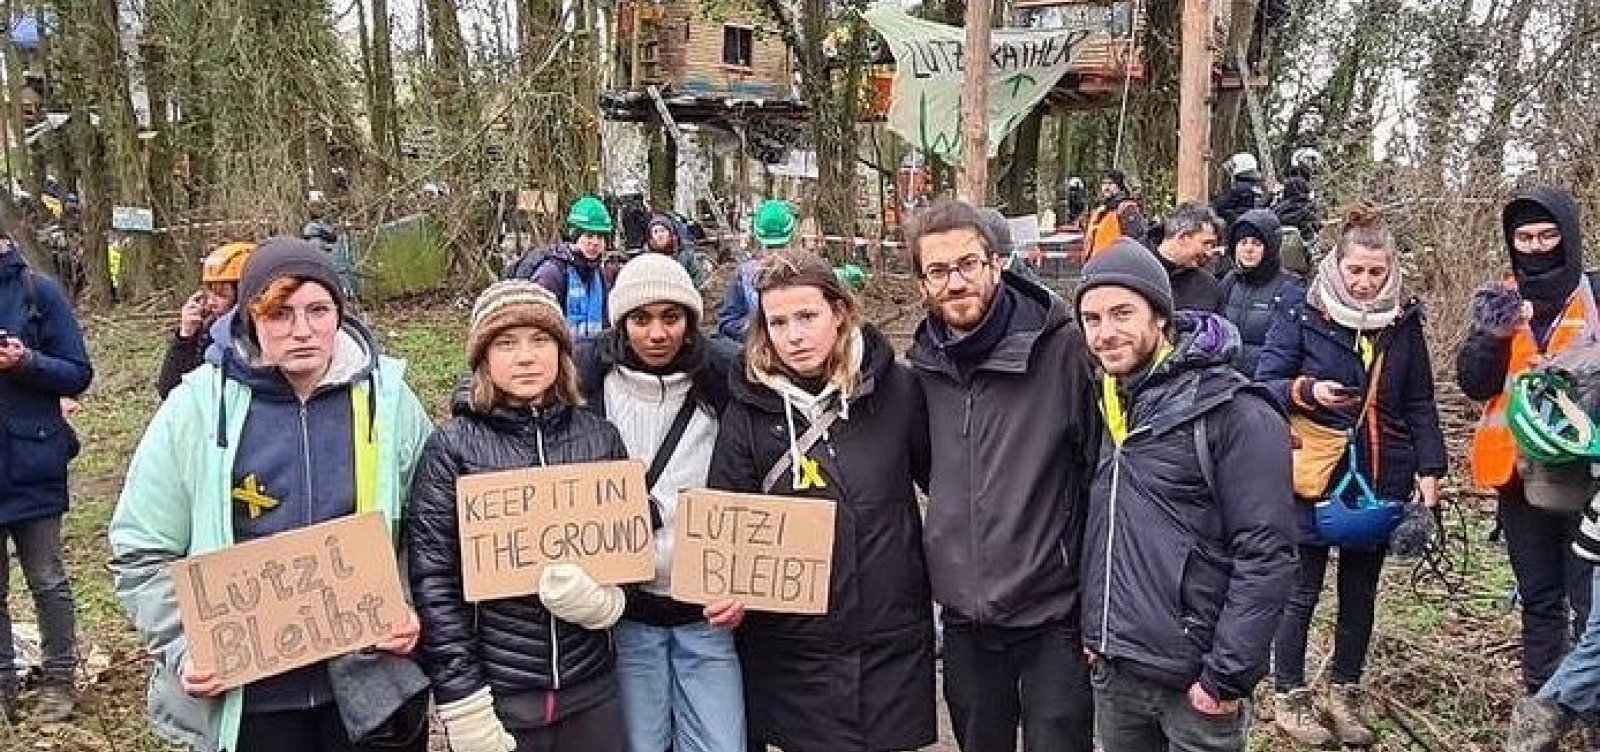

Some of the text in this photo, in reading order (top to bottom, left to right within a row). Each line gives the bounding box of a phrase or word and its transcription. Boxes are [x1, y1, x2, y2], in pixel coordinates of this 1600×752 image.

[465, 476, 628, 522] KEEP IT IN
[686, 497, 786, 546] LÜTZI
[466, 515, 650, 573] THE GROUND
[188, 534, 354, 623] Lützi
[702, 548, 826, 602] BLEIBT
